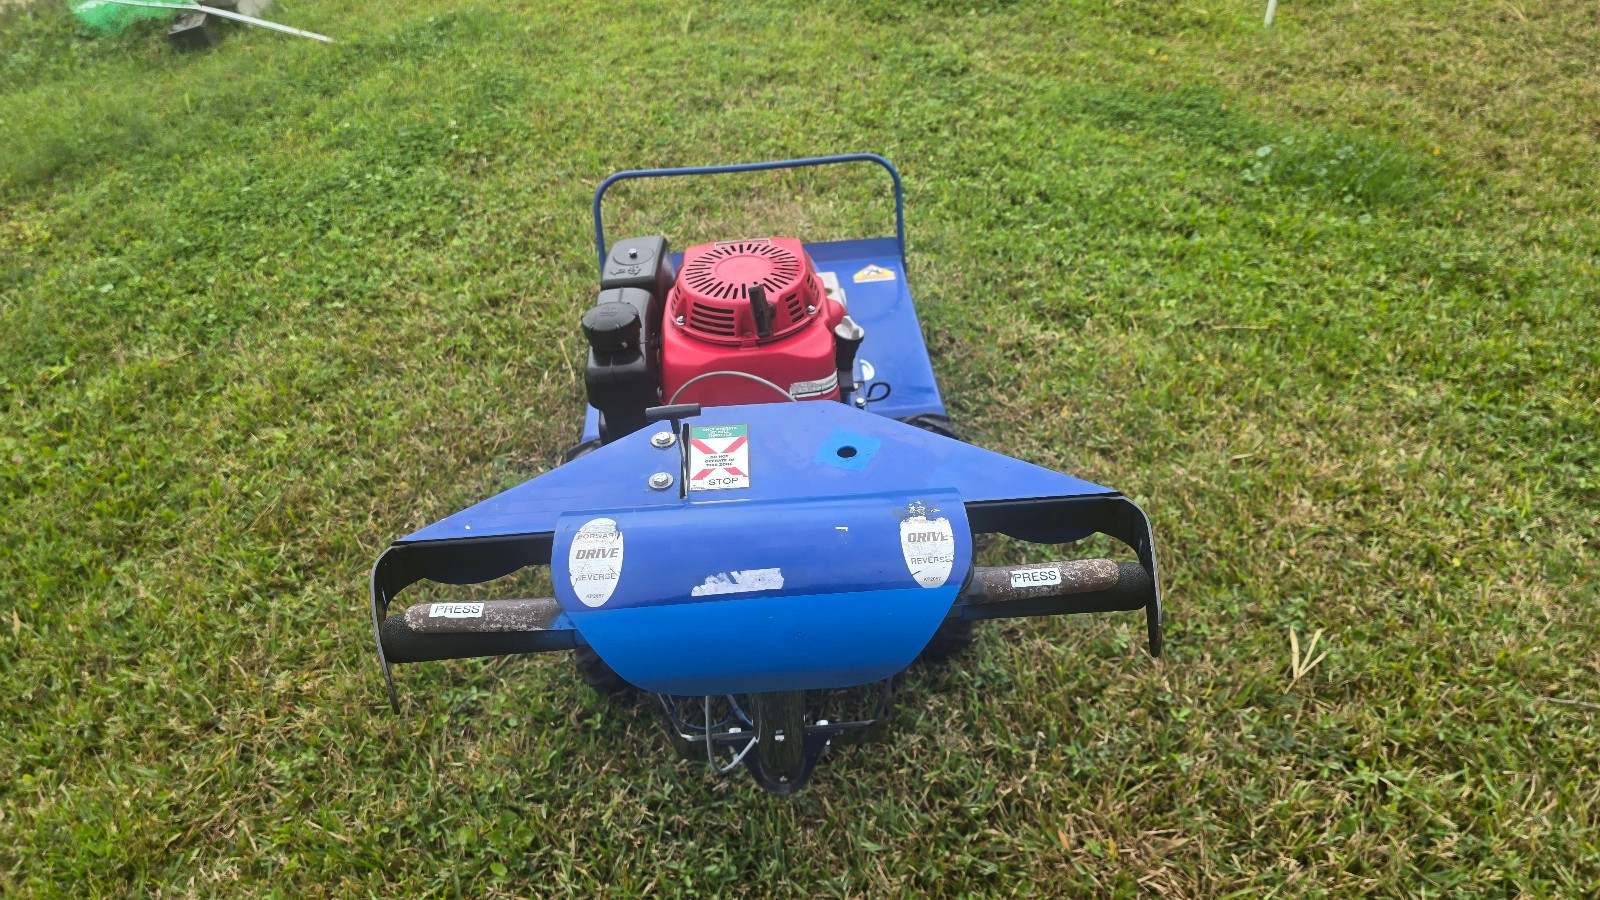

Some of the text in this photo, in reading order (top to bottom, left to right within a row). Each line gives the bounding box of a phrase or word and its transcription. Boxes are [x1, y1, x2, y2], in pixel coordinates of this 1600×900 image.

[708, 477, 739, 486] STOP
[907, 531, 949, 543] DRIVE
[575, 547, 620, 560] DRIVE
[911, 555, 951, 565] REVERSE
[1013, 570, 1057, 583] PRESS
[434, 605, 481, 614] PRESS
